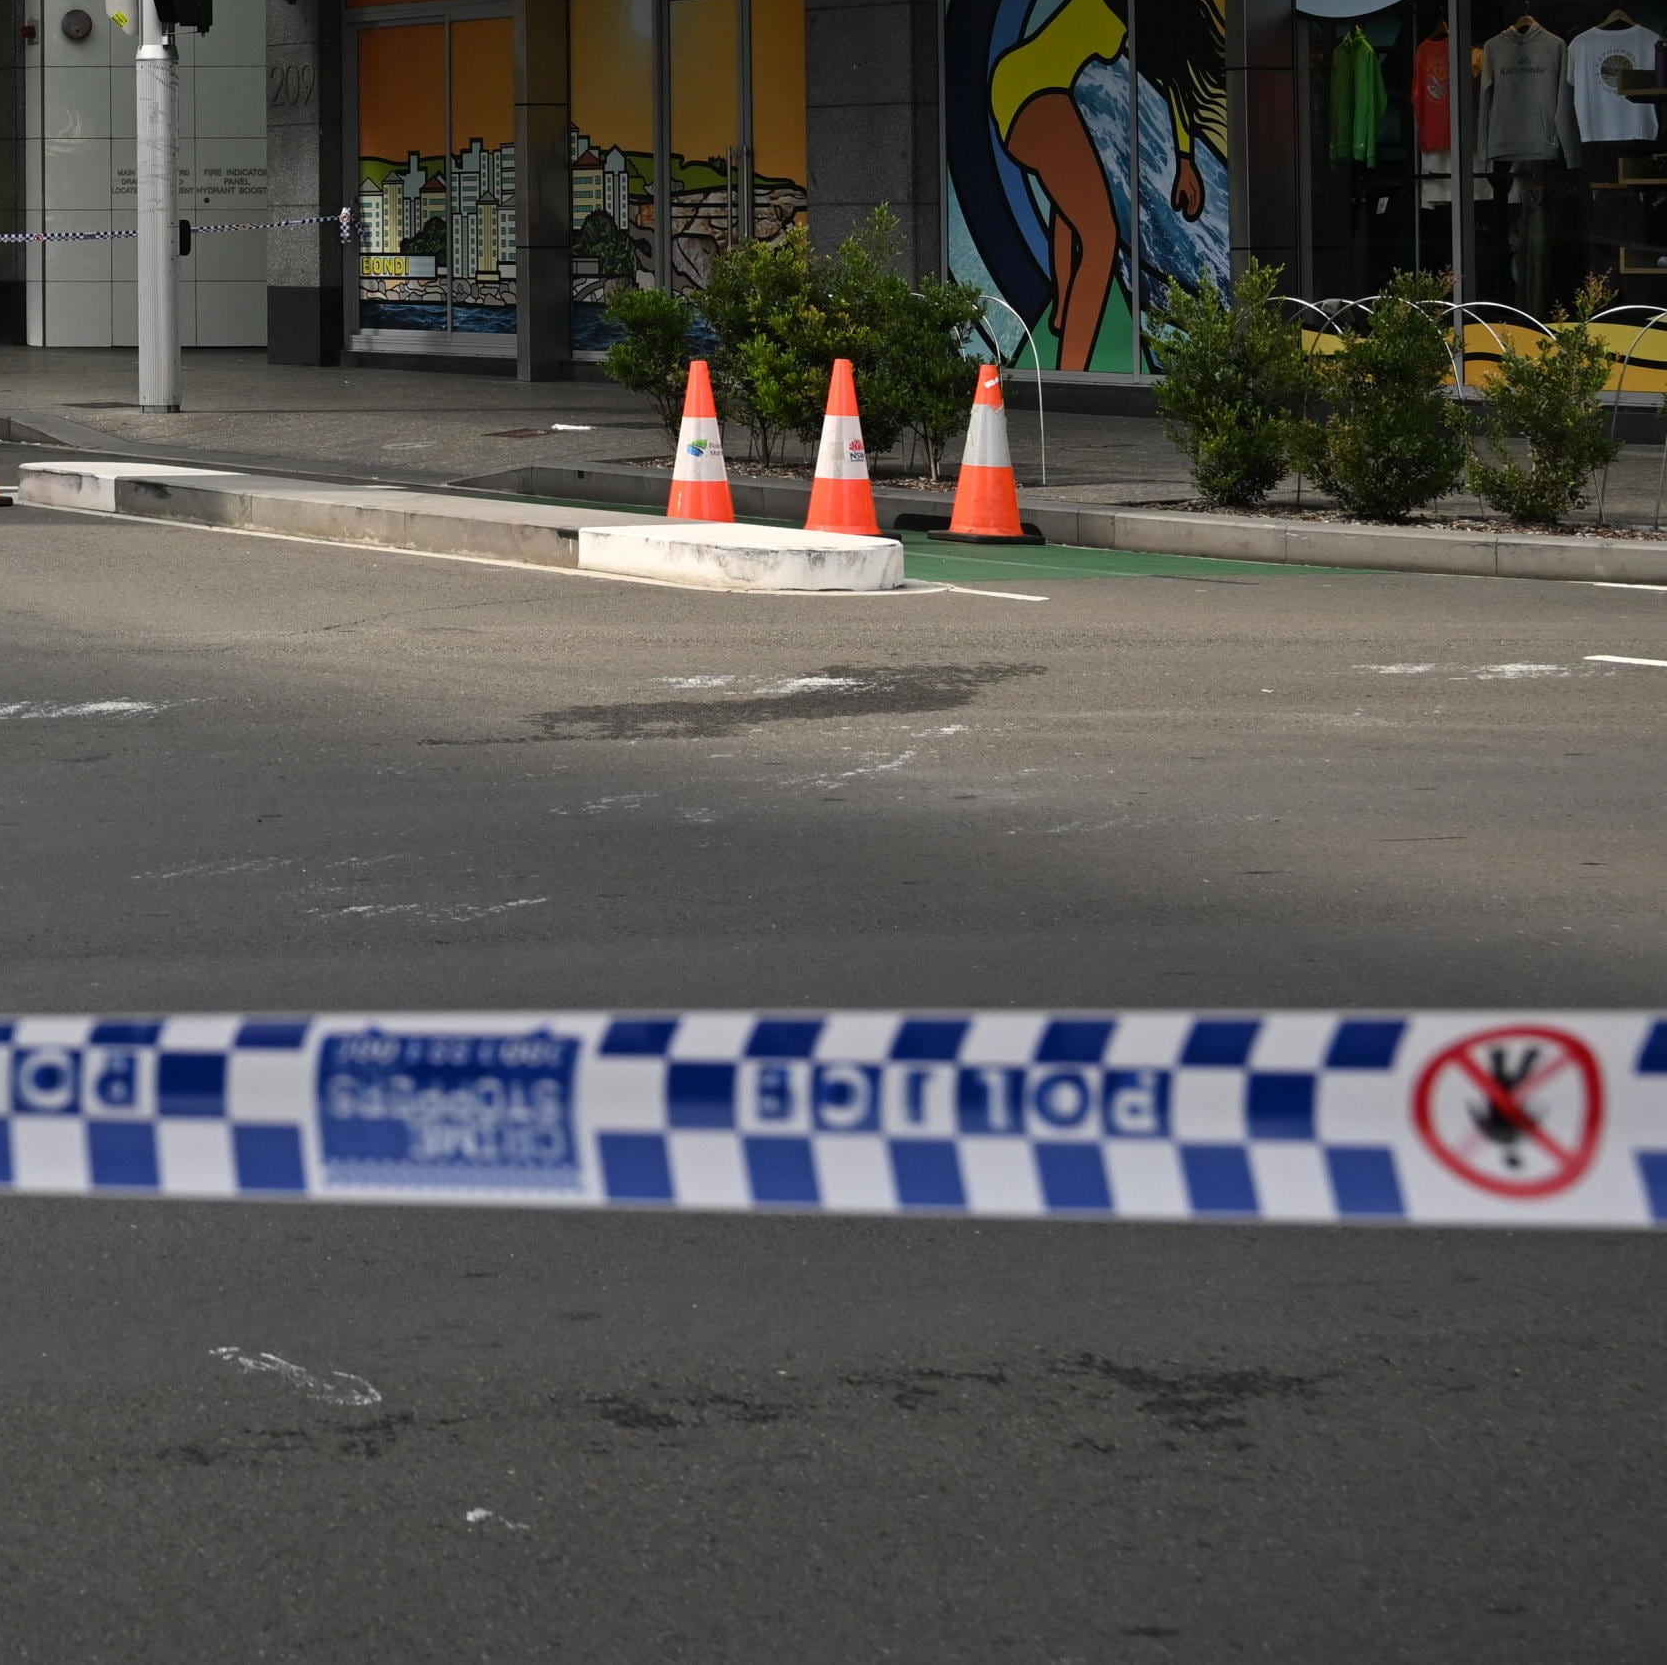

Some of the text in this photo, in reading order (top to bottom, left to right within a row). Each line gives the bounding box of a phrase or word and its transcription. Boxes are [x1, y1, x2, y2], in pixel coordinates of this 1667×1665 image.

[270, 65, 315, 107] 209
[204, 168, 222, 176] FIRE
[361, 256, 409, 276] BONDI
[755, 1069, 1158, 1131] POLICE
